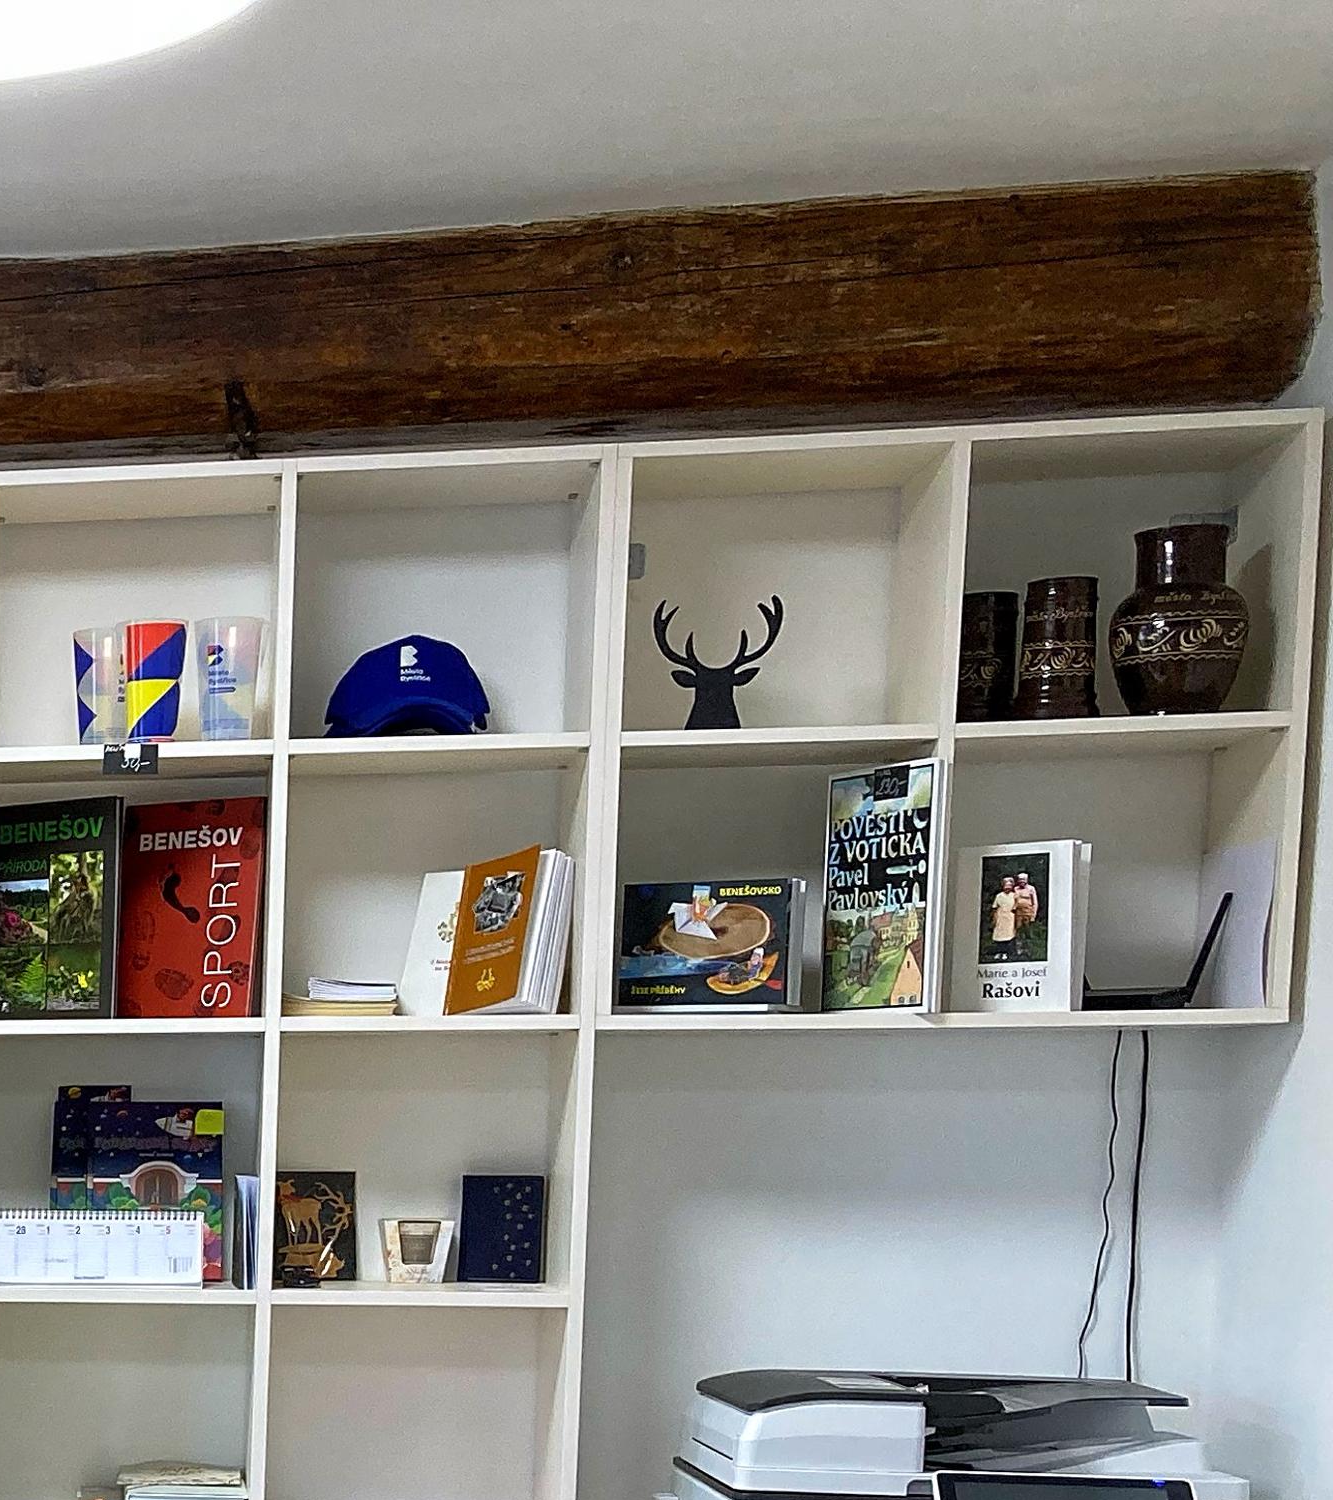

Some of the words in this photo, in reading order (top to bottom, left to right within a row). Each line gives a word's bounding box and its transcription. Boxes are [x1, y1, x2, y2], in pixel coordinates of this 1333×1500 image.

[0, 815, 104, 845] BENEŠOV
[139, 825, 243, 852] BENEŠOV
[831, 810, 906, 842] POVĚSTI
[828, 843, 841, 865] Z
[843, 831, 927, 863] VOTICKA
[828, 862, 869, 888] Pavel
[719, 884, 782, 897] BENEŠOVSKO
[827, 880, 909, 912] Pavlovský
[200, 854, 242, 1009] SPORT
[977, 969, 1008, 979] Marie
[1011, 970, 1018, 978] a
[1021, 967, 1047, 979] Josef
[981, 980, 1040, 999] Rašovi
